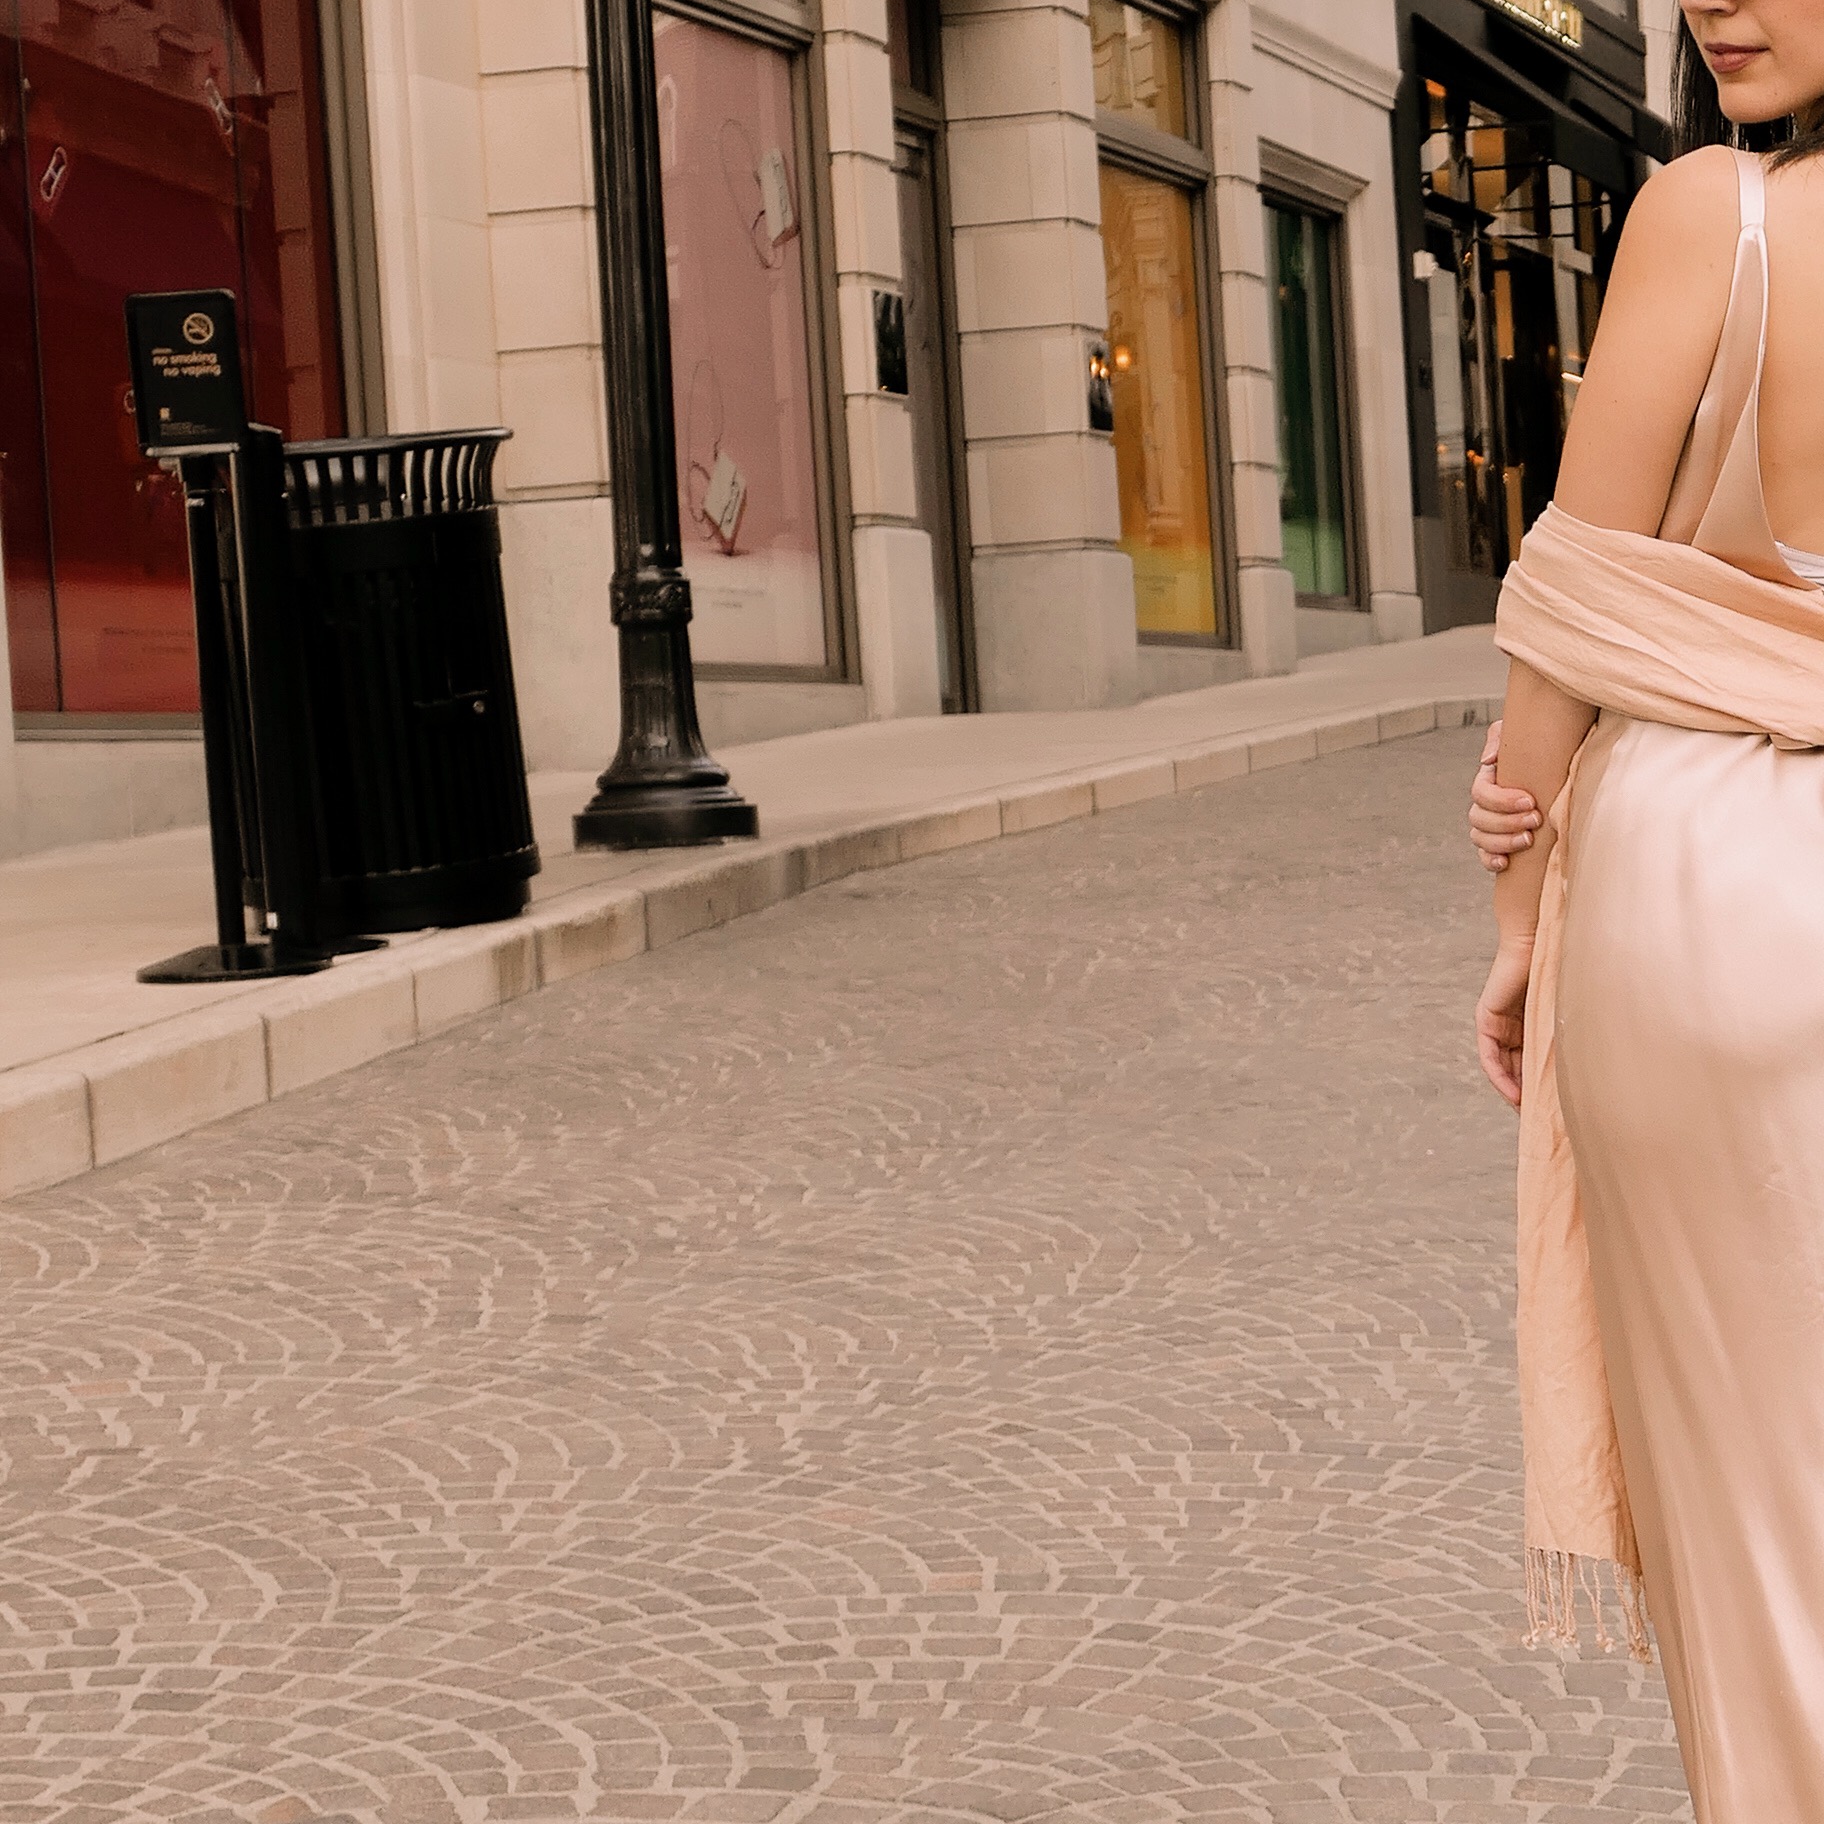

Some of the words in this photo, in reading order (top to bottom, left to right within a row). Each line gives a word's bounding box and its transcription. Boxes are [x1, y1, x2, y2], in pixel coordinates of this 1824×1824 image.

[153, 356, 168, 366] no
[170, 351, 217, 365] smoking
[163, 367, 179, 377] no
[180, 364, 222, 378] vaping
